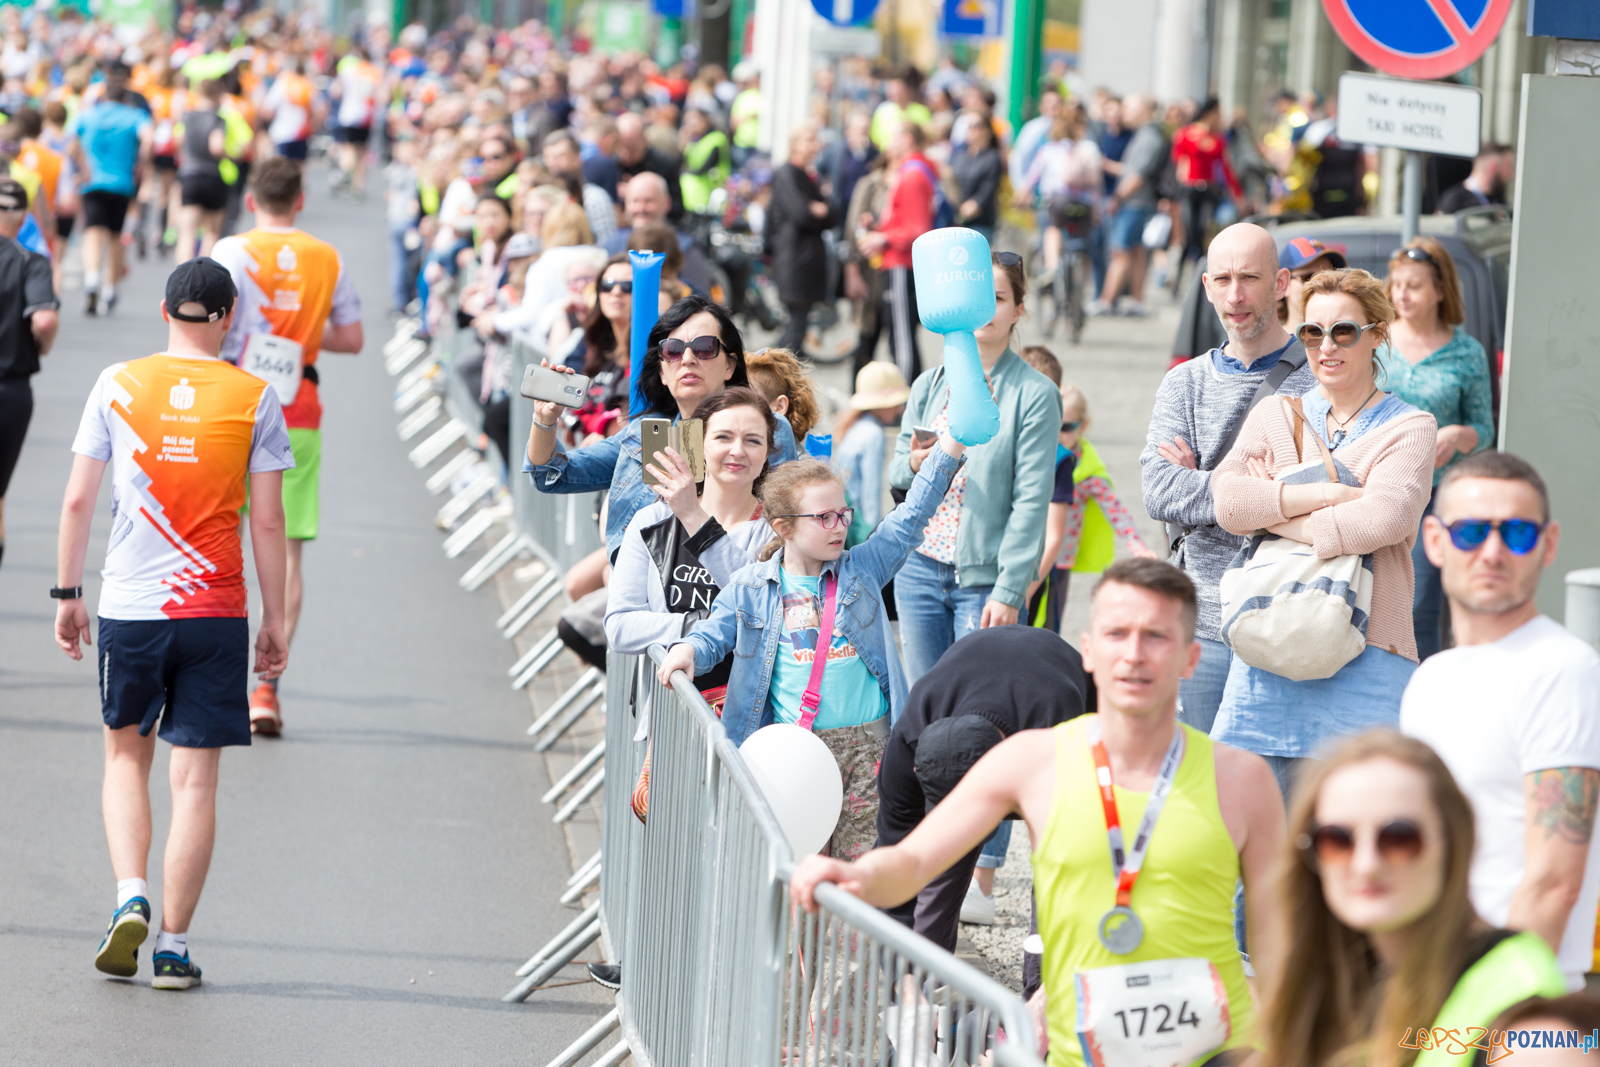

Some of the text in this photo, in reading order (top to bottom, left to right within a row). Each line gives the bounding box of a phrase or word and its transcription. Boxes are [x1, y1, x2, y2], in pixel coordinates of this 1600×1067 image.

[1367, 92, 1389, 106] Nie
[1367, 118, 1444, 140] TAXI HOTEL
[934, 270, 985, 284] ZURICH
[160, 412, 200, 423] Bank Polski
[163, 435, 177, 446] Mój
[164, 453, 199, 463] Poznaniu
[827, 645, 857, 660] Bella
[1114, 1000, 1201, 1038] 1724
